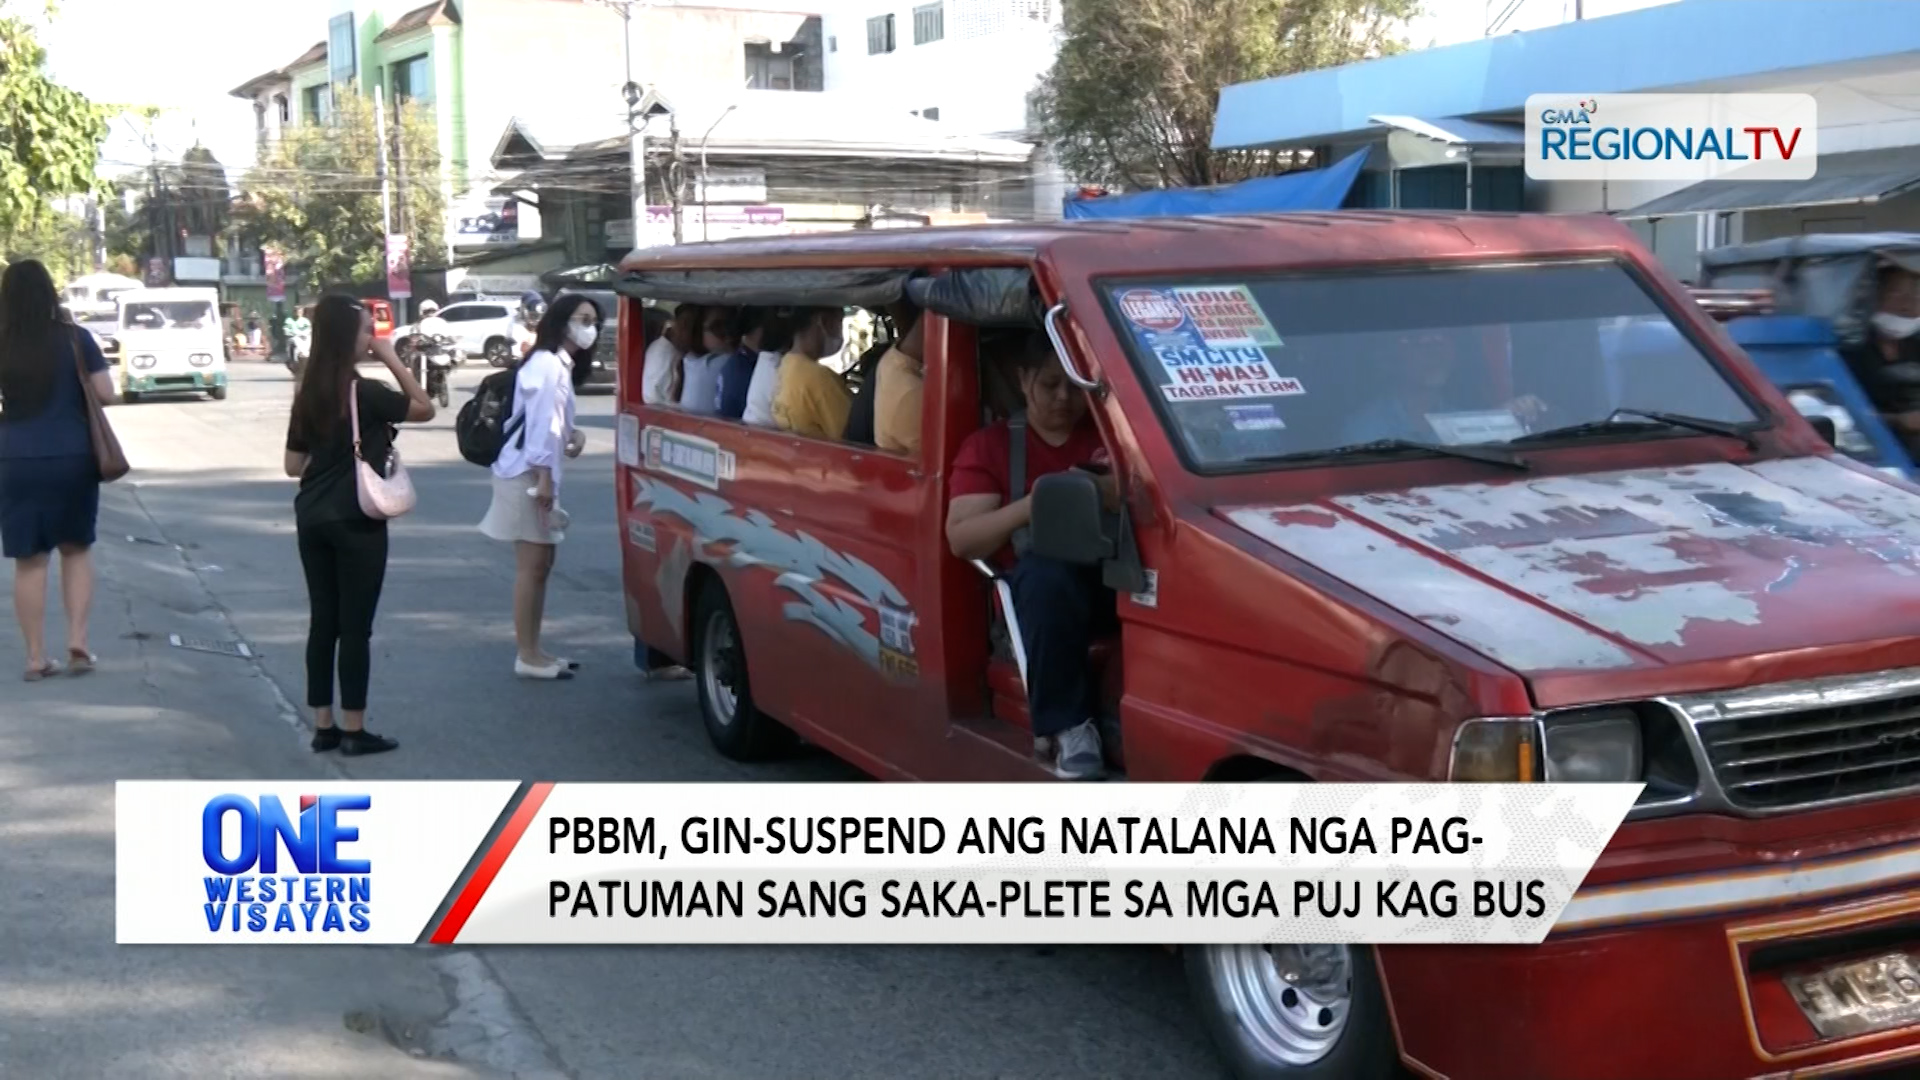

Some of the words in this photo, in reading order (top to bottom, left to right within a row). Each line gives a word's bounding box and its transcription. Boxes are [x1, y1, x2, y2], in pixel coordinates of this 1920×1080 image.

[1178, 291, 1248, 304] ILOILO
[1185, 304, 1258, 317] LEGANES
[1161, 350, 1203, 366] SM
[1205, 347, 1264, 364] CITY
[1177, 364, 1270, 383] HI-WAY
[1166, 384, 1244, 398] TAGBAK
